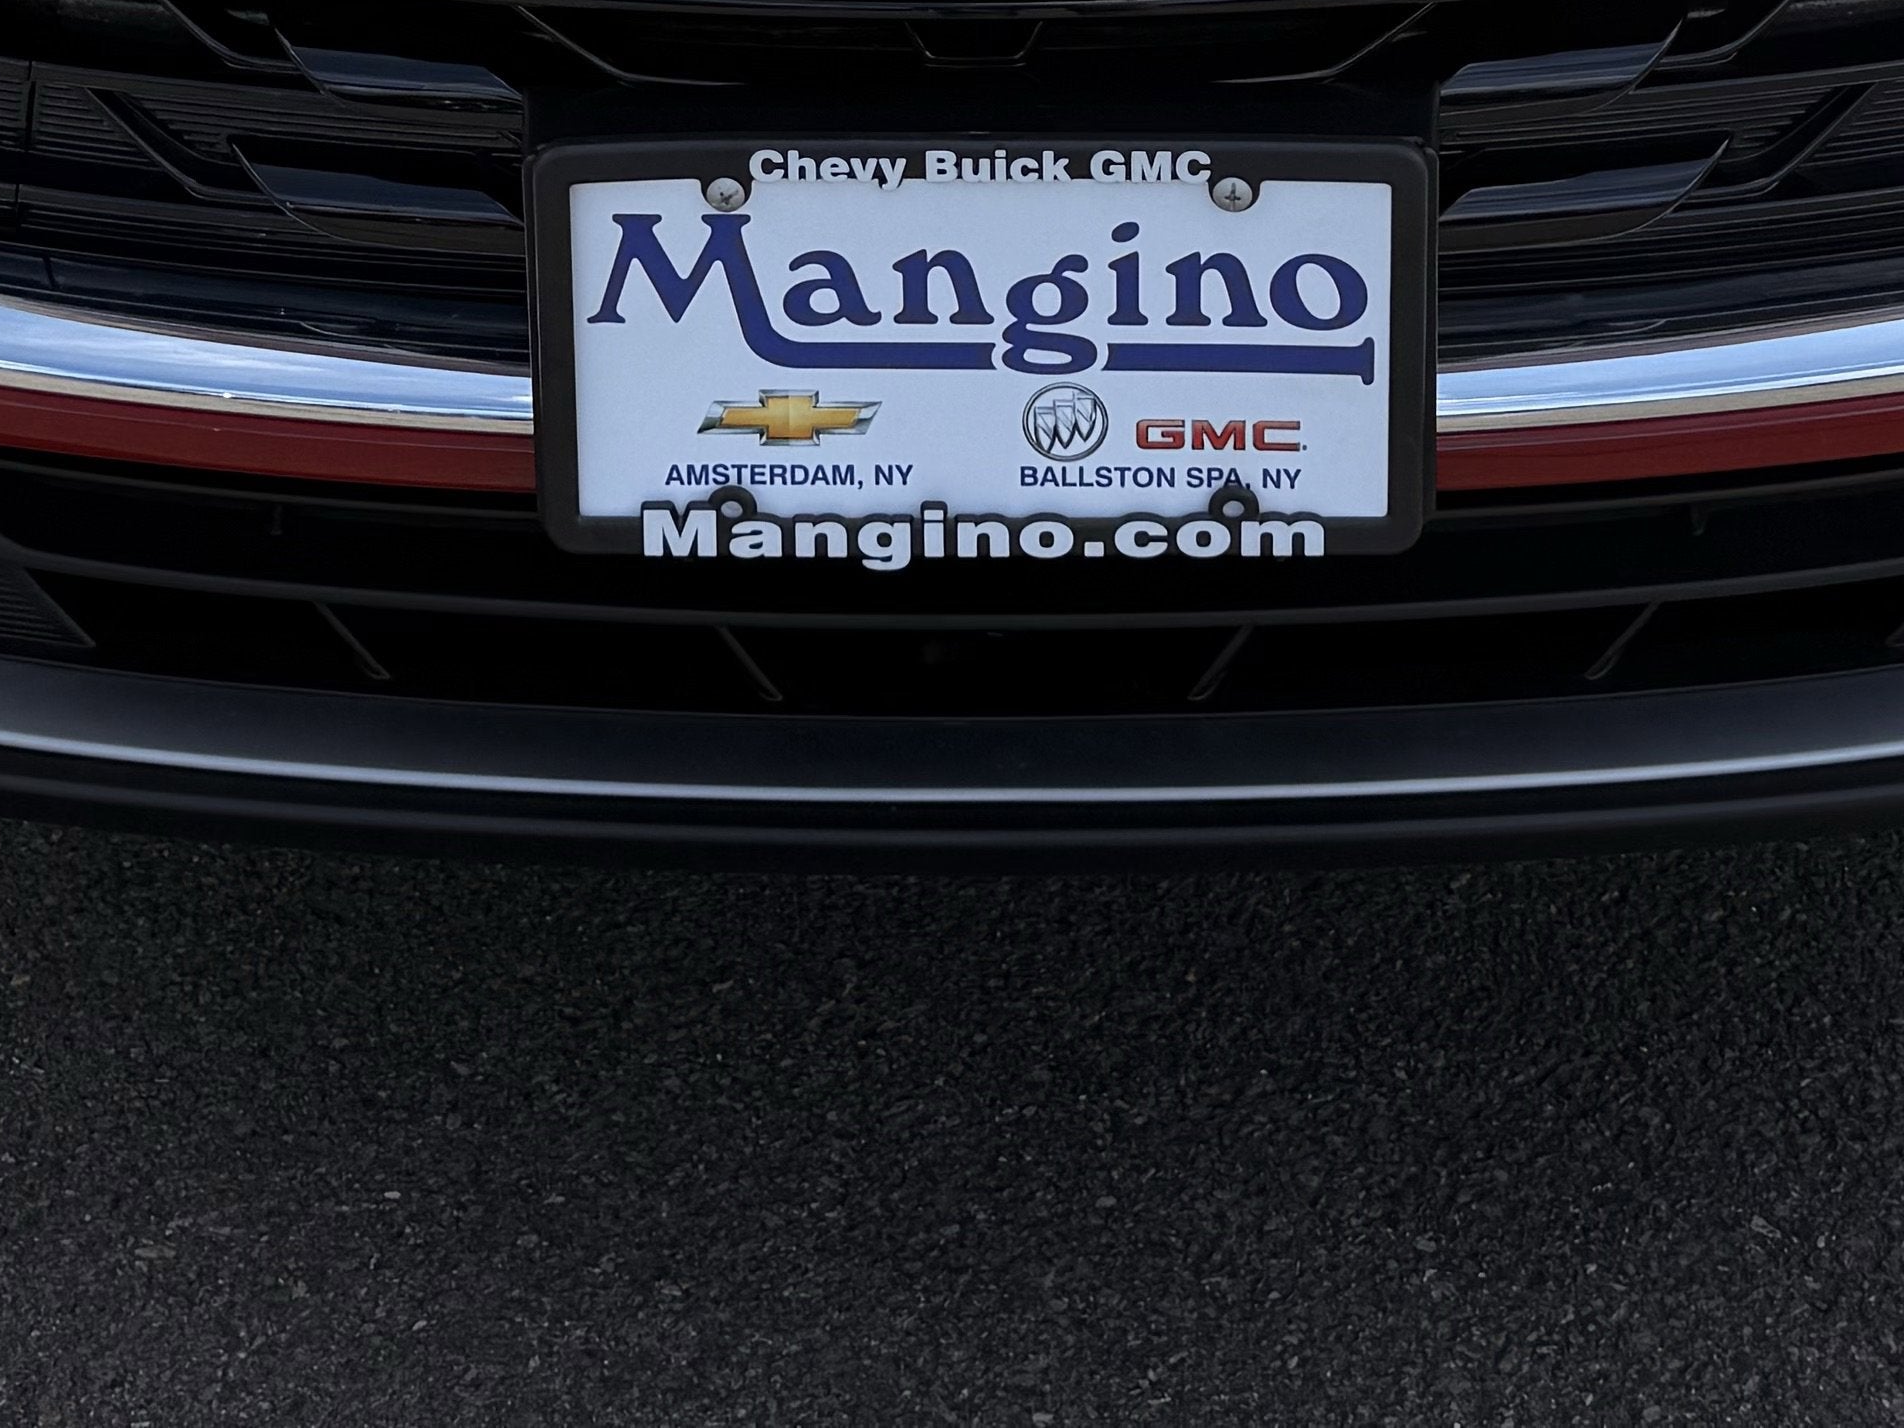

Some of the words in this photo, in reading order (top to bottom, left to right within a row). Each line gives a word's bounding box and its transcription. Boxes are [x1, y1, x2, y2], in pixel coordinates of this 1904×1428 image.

[748, 149, 907, 191] Chevy
[925, 149, 1071, 183] Buick
[1089, 149, 1213, 184] GMC
[586, 213, 1375, 385] Mangino
[1135, 419, 1302, 452] GMC
[664, 463, 864, 490] AMSTERDAM,
[874, 463, 914, 486] NY
[1019, 465, 1176, 488] BALLSTON
[1185, 466, 1251, 491] SPA,
[1261, 467, 1302, 490] NY
[642, 508, 1326, 572] Mangino.com
